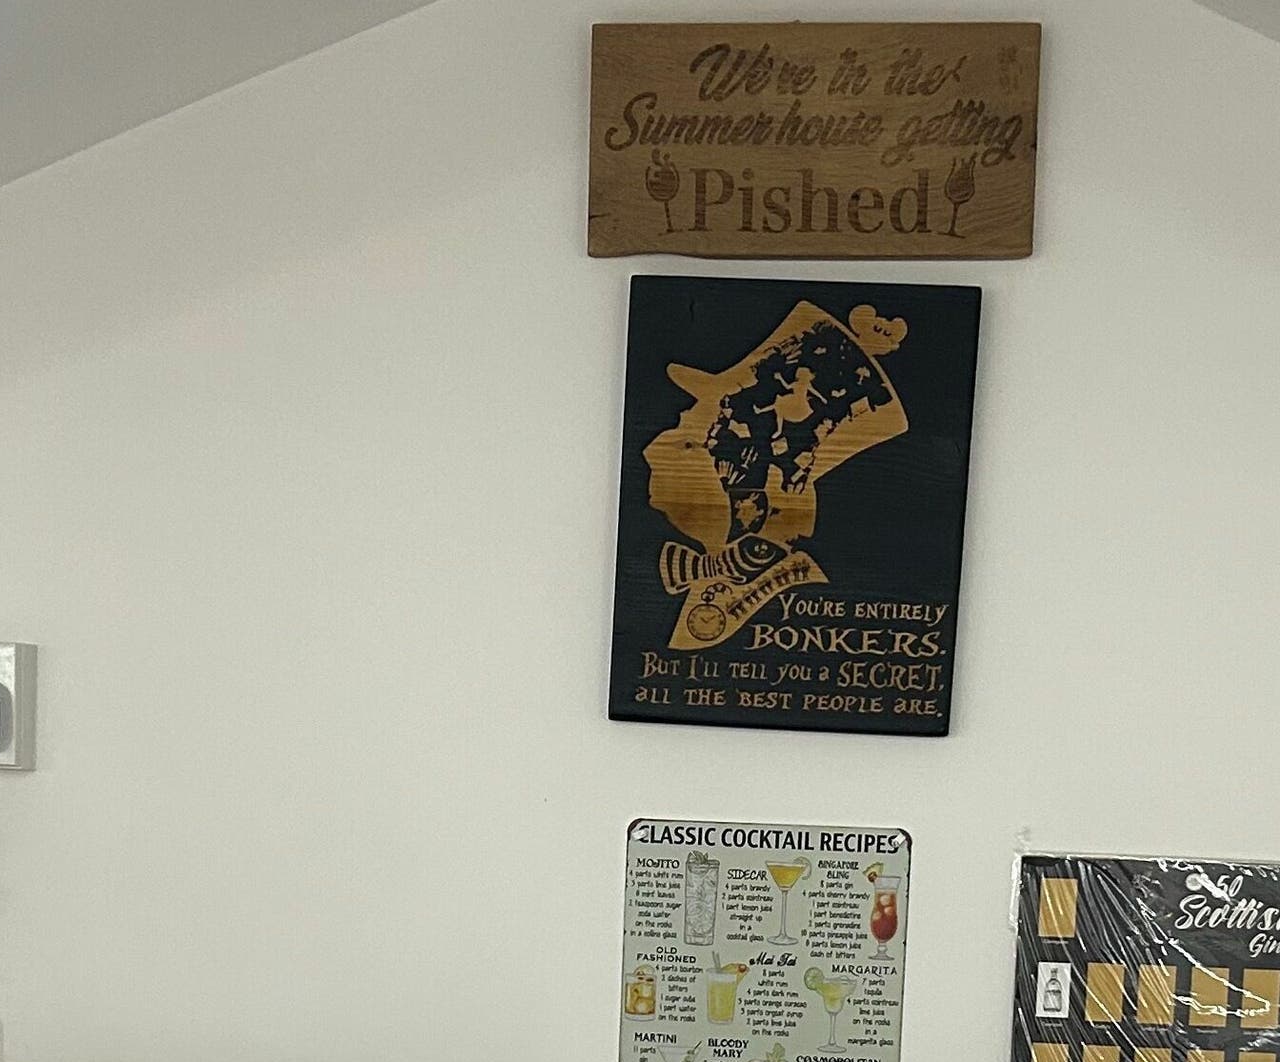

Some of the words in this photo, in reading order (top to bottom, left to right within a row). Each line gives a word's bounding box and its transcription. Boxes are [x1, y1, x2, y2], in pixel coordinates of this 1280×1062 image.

[828, 47, 871, 97] in
[884, 47, 970, 97] the
[880, 99, 1022, 167] getting
[688, 167, 932, 233] Pished
[747, 624, 947, 658] BONKERS.
[836, 661, 945, 692] SECRET,
[683, 688, 727, 706] THE
[736, 690, 792, 710] BEST
[802, 694, 884, 714] PEOPLE
[639, 824, 717, 847] CLASSIC
[721, 828, 814, 851] COCKTAIL
[820, 831, 899, 854] RECIPES
[636, 858, 680, 868] MOJITO
[727, 869, 768, 880] SIDECAR
[1217, 874, 1243, 897] 50
[636, 953, 697, 963] FASHIONED
[777, 952, 797, 966] Tai
[832, 964, 897, 977] MARGARITA
[634, 1032, 677, 1044] MARTINI
[708, 1038, 749, 1049] BLOODY
[713, 1049, 743, 1058] MARY
